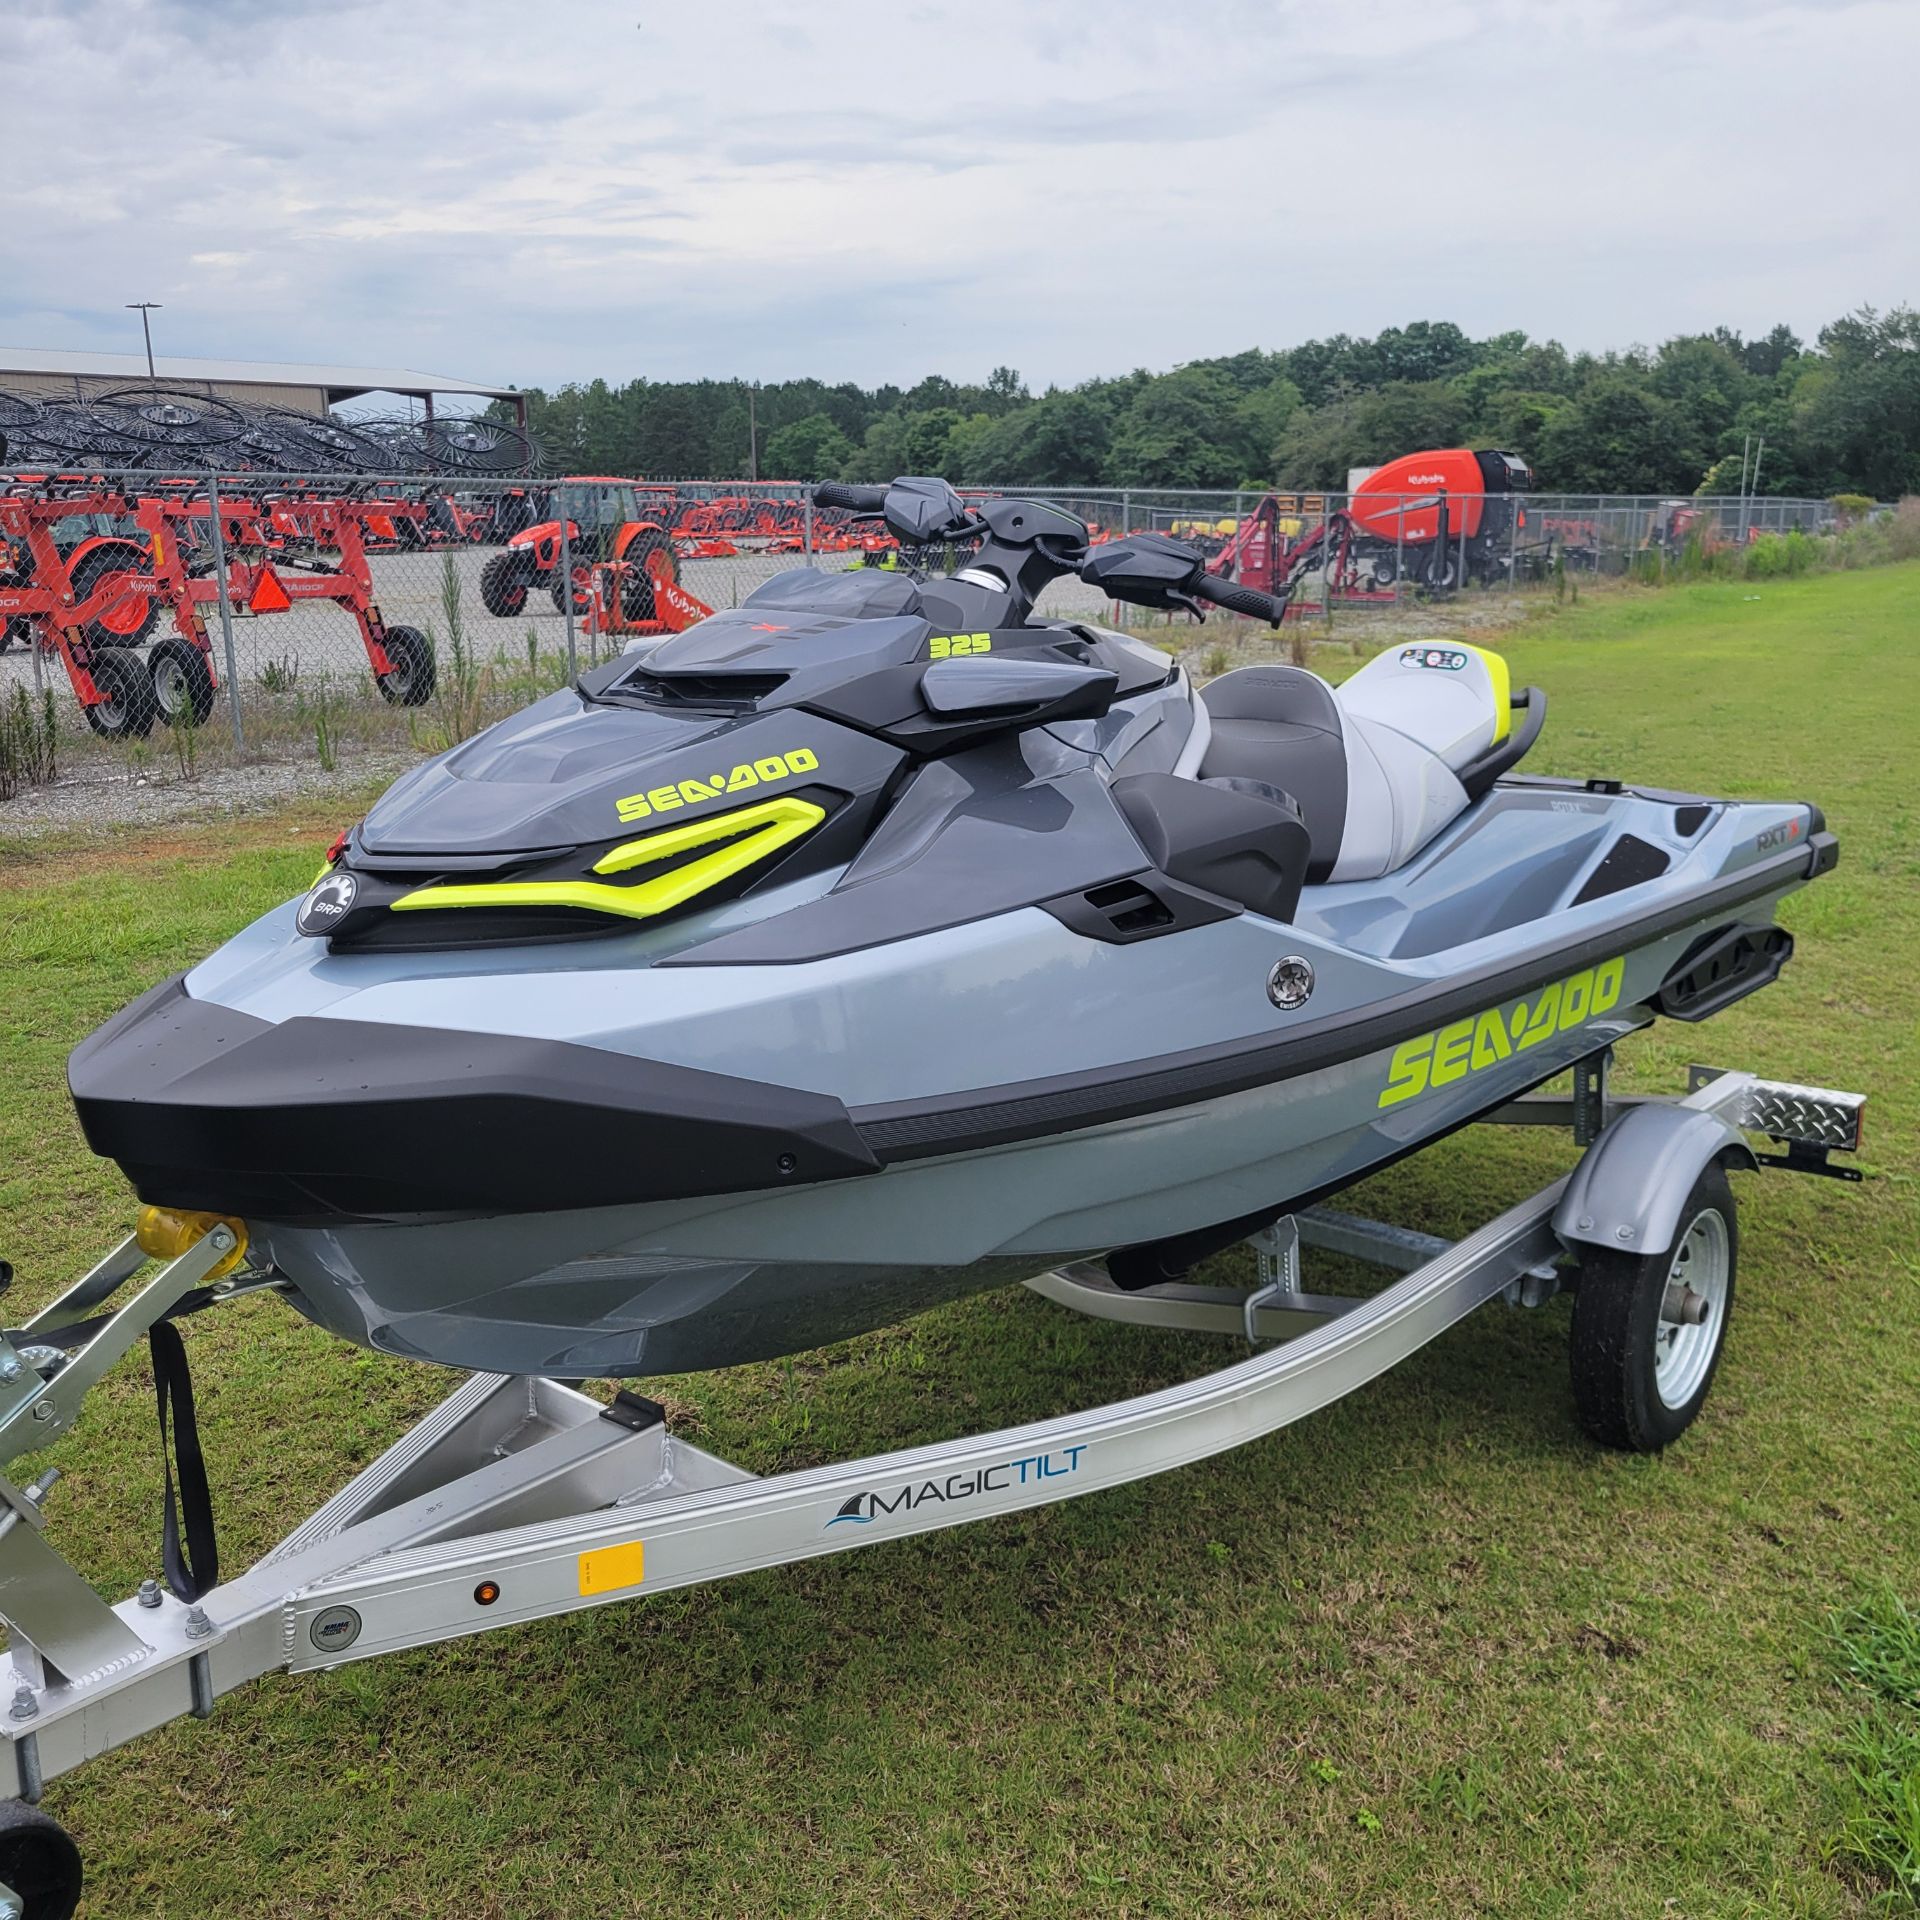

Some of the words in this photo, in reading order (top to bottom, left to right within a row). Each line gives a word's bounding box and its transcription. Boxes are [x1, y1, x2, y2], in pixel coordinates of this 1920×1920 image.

[667, 587, 707, 621] Kubota
[930, 633, 991, 659] 325
[314, 902, 343, 916] BRP
